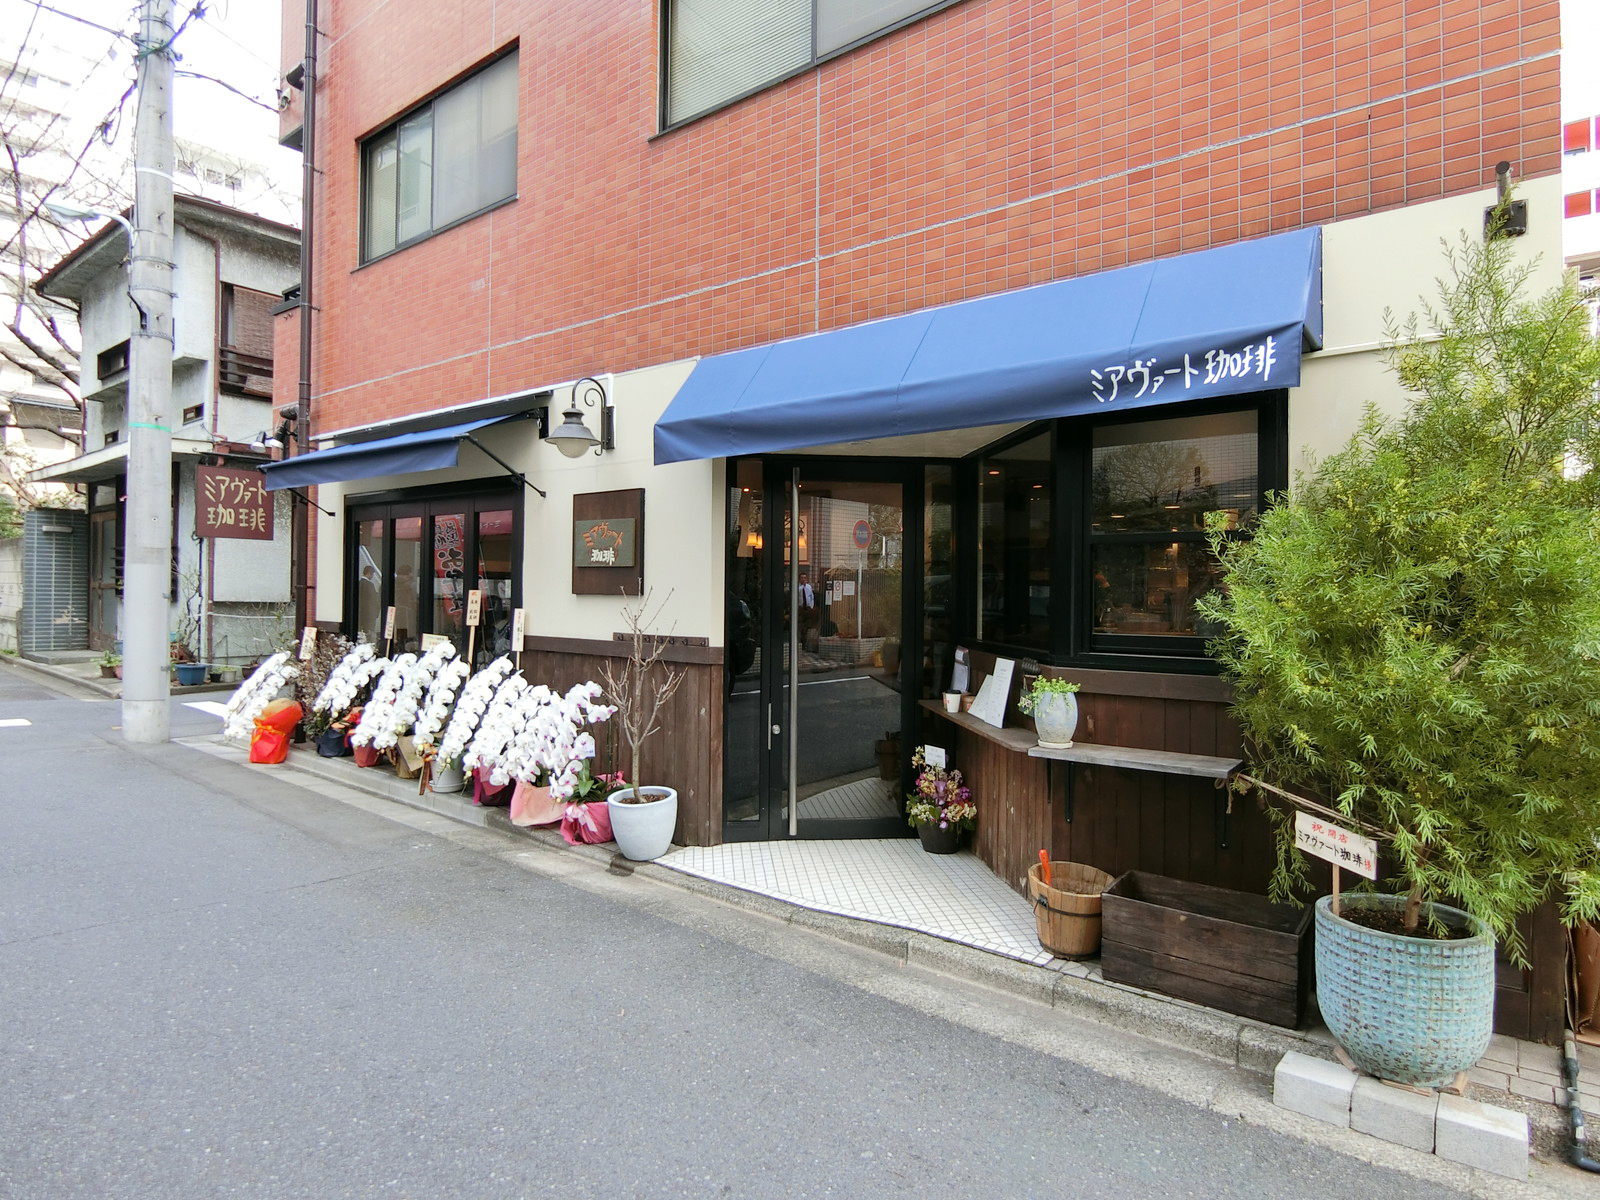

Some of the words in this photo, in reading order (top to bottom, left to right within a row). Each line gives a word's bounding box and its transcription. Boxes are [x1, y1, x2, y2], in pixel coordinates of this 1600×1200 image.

[204, 474, 268, 505] ミアヴァート
[207, 503, 266, 533] 珈琲
[590, 546, 616, 566] 珈琲
